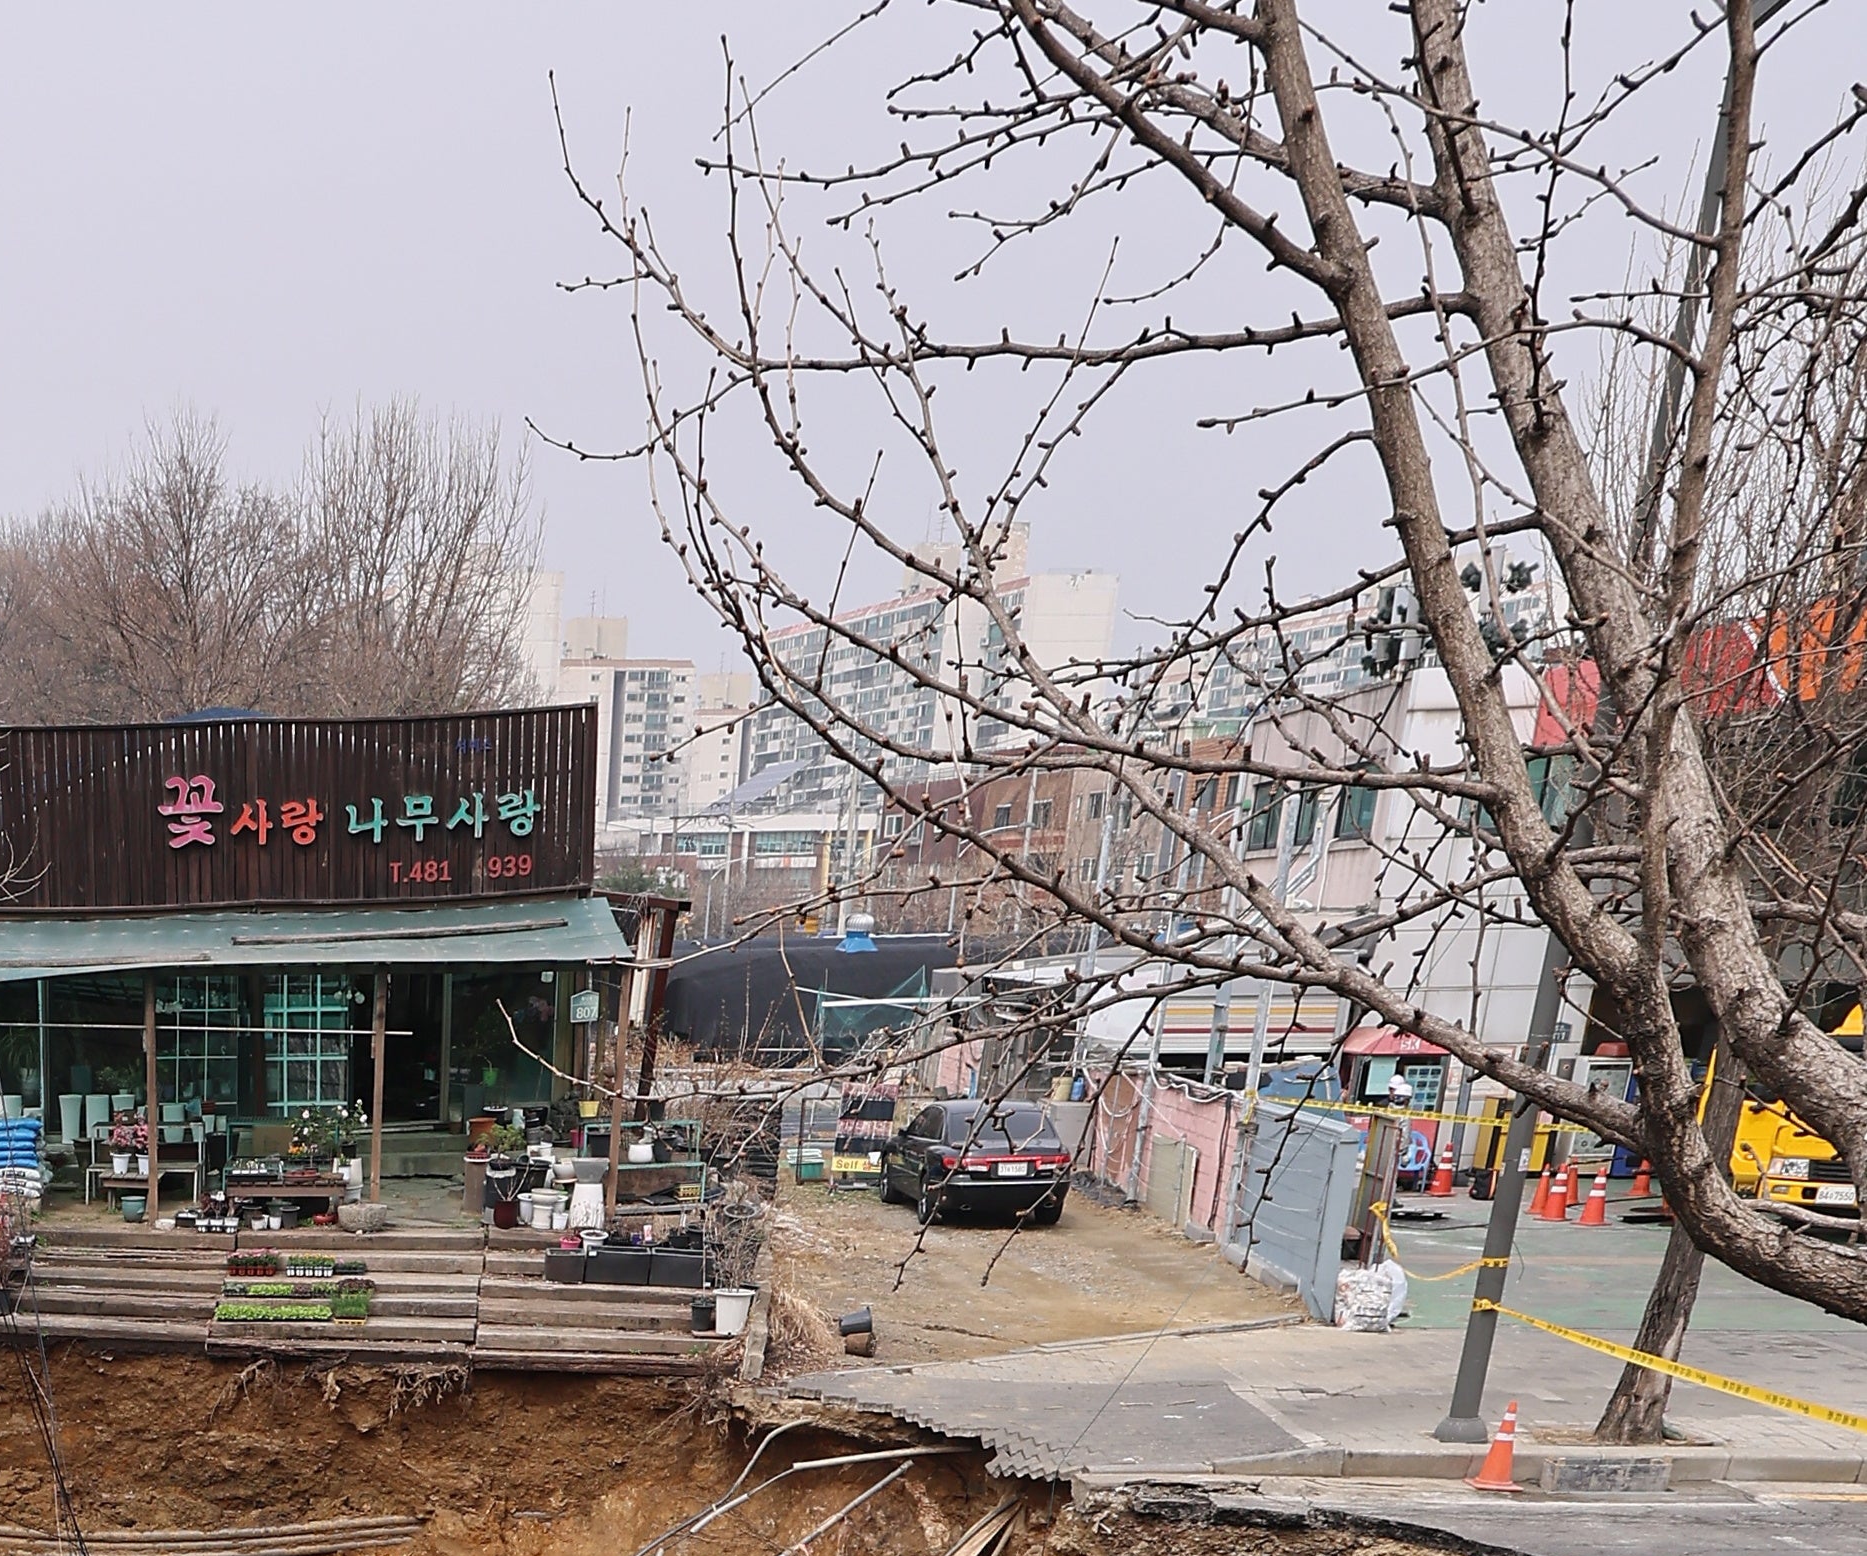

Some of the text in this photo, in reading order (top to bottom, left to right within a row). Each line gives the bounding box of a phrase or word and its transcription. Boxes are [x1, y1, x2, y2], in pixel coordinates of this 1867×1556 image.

[157, 774, 542, 848] 꽃사랑 나무사랑
[389, 854, 533, 884] T.481 939
[576, 1006, 598, 1019] 807
